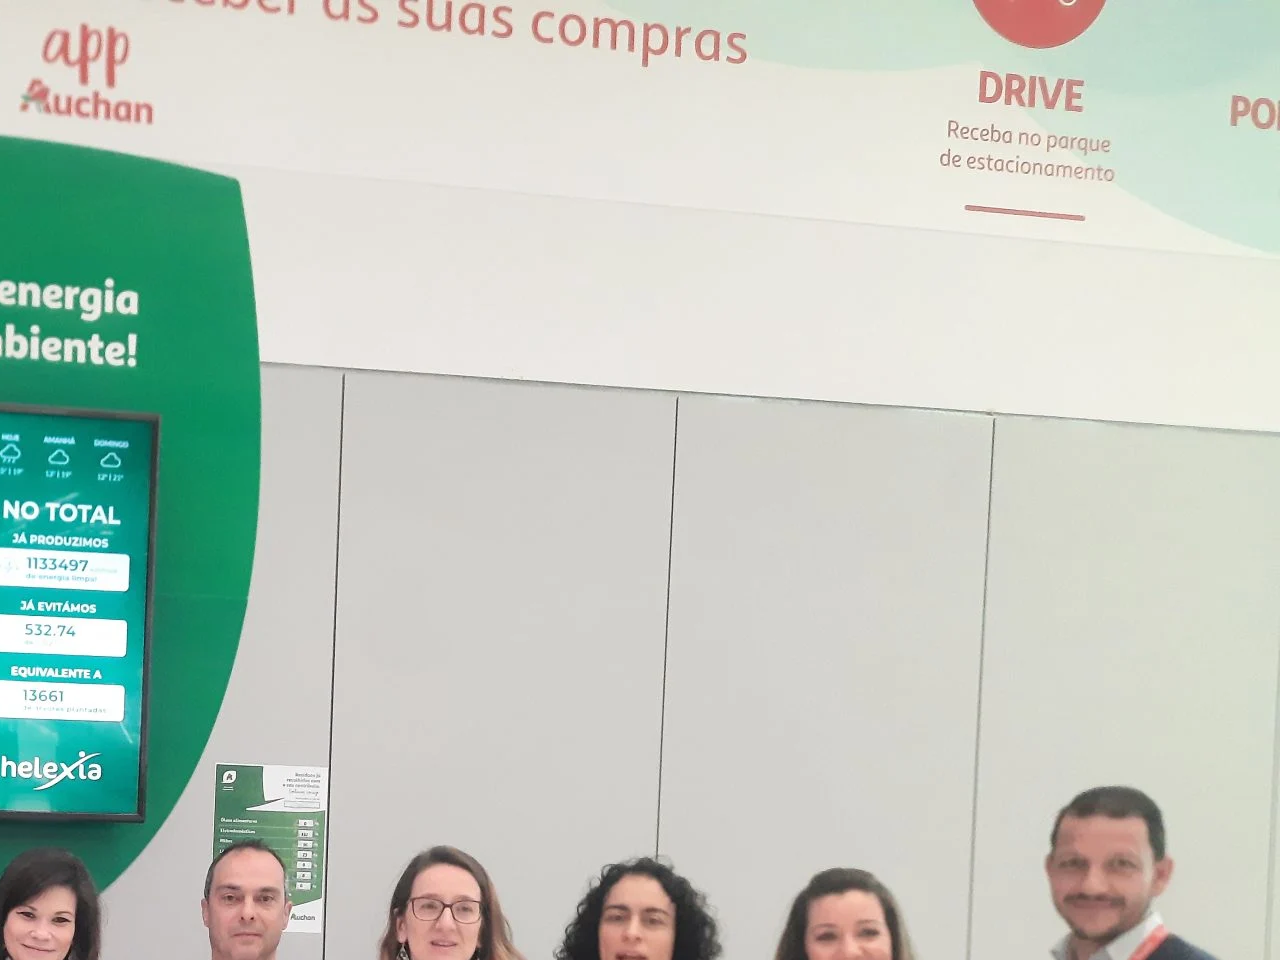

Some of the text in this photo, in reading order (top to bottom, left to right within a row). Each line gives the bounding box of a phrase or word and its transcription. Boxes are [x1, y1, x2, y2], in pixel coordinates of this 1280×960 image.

[397, 0, 514, 39] suas
[530, 9, 748, 68] compras
[41, 22, 130, 87] app
[20, 78, 154, 126] Auchan
[978, 70, 1086, 113] DRIVE
[1230, 94, 1280, 131] PO
[947, 120, 1111, 156] Receba no parque
[939, 149, 1116, 182] de estacionamento
[3, 500, 121, 525] NO TOTAL
[12, 532, 109, 548] JÁ PRODUZIMOS
[26, 556, 89, 572] 1133497
[20, 599, 97, 614] JÁ EVITÁMOS
[24, 623, 76, 637] 532.74
[10, 665, 103, 679] EQUIVALENTE A
[23, 689, 64, 702] 13661
[0, 751, 102, 791] helexia
[290, 912, 316, 921] Auchan
